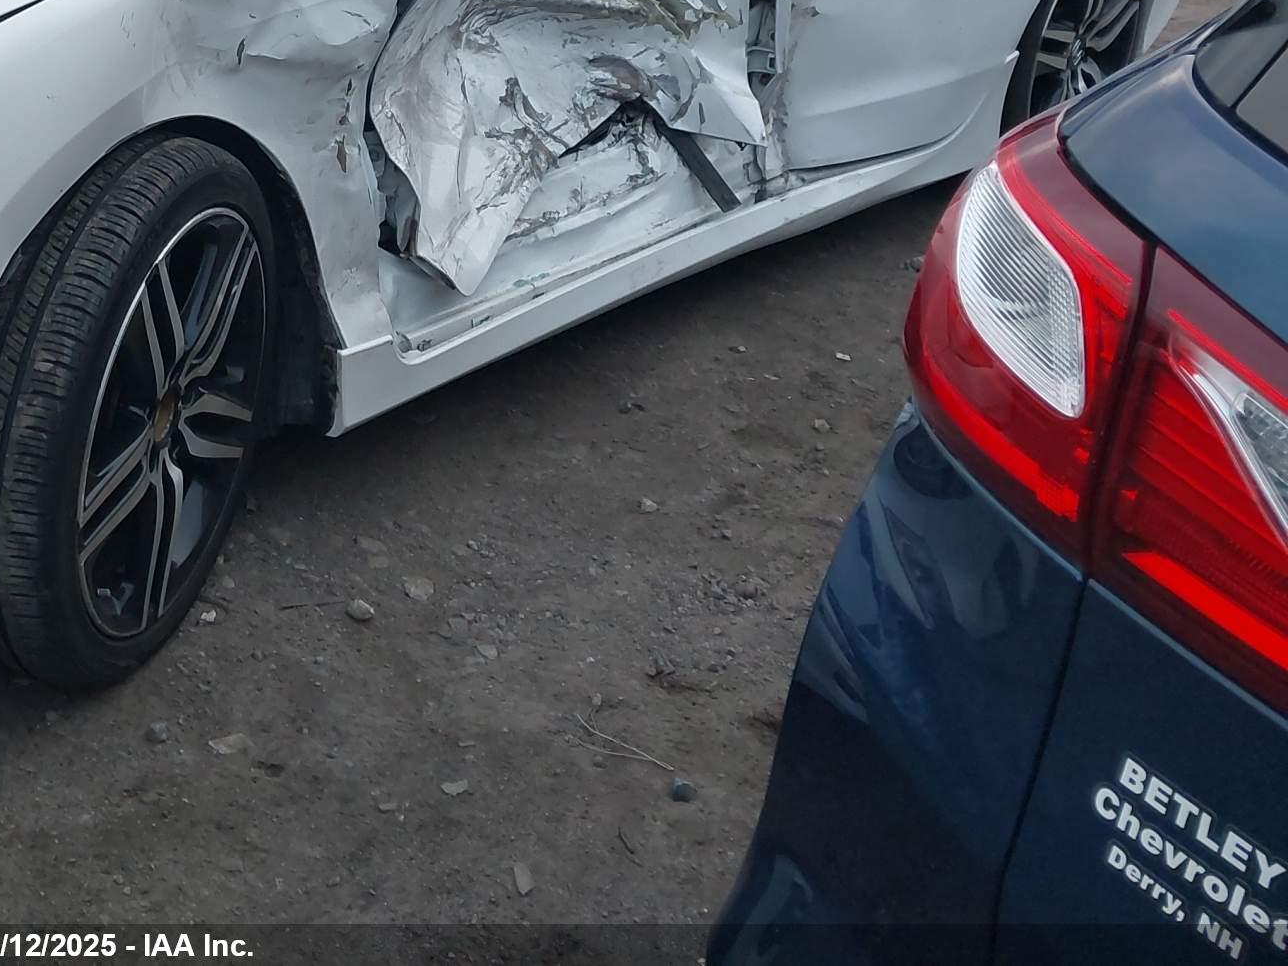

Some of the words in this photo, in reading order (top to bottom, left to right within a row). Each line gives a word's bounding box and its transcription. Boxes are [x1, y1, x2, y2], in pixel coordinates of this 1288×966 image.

[1118, 756, 1287, 890] BETLEY
[1107, 844, 1187, 922] Derry,
[1196, 911, 1244, 960] NH
